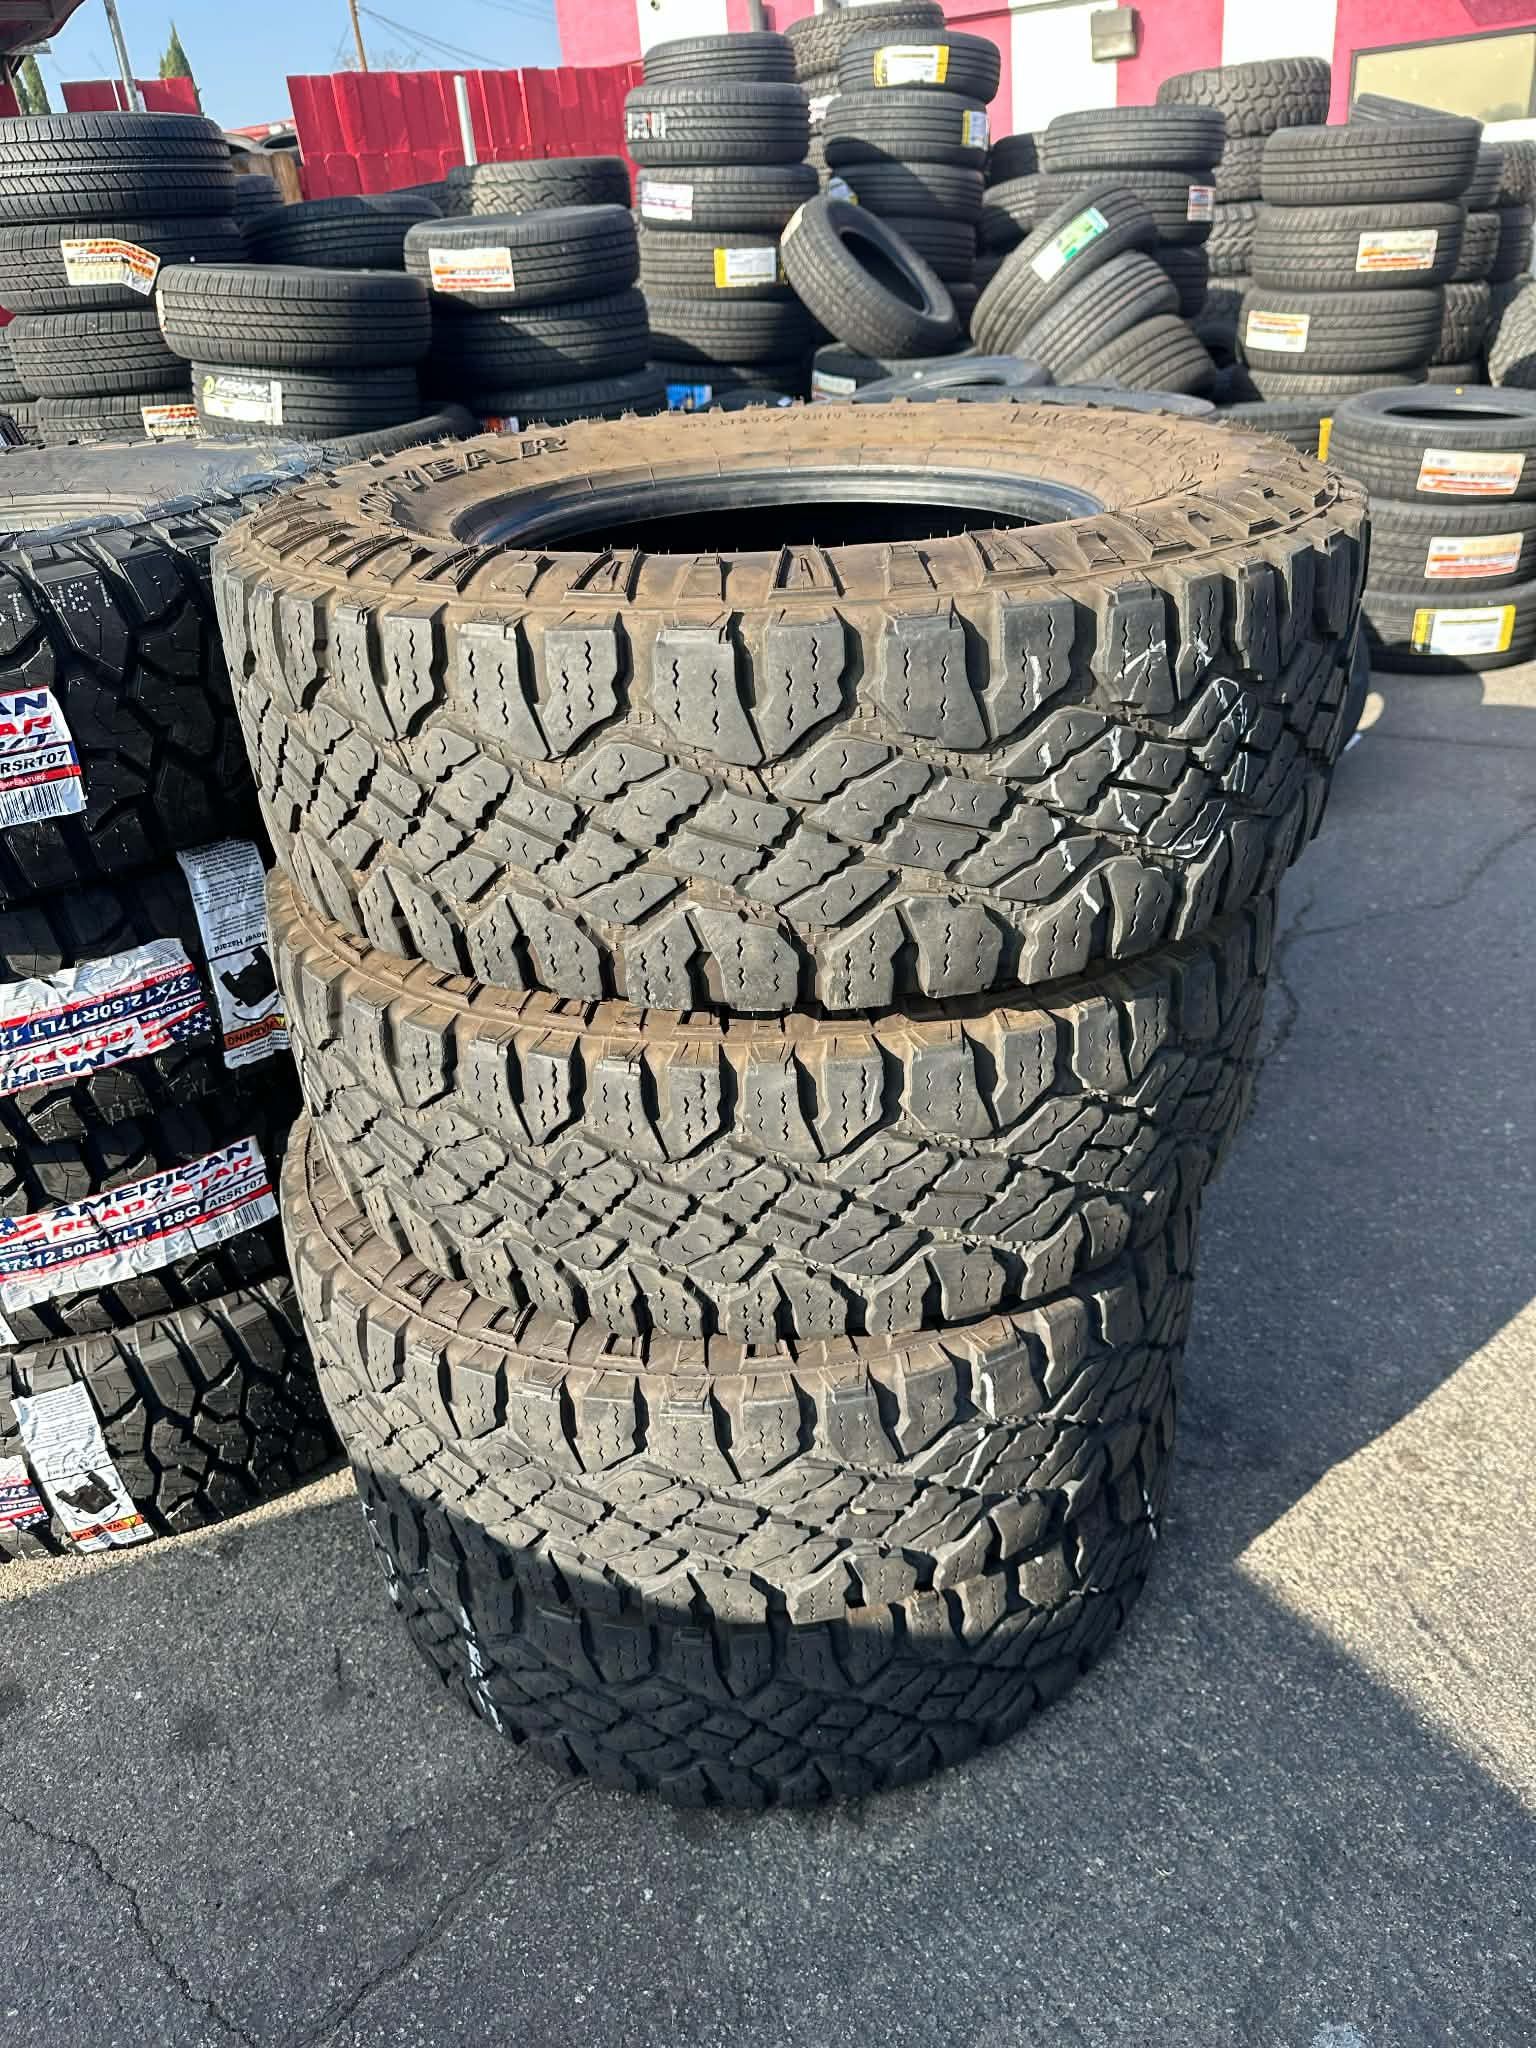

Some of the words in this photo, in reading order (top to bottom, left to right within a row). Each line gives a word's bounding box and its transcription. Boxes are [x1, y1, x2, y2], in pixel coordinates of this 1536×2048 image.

[214, 938, 243, 954] Hazard
[31, 975, 192, 1039] 37x12.50R17LT
[141, 1009, 160, 1022] USA
[32, 1027, 136, 1065] ROAD
[50, 1140, 250, 1221] AMERICAN
[52, 1199, 145, 1237] ROAD
[171, 1156, 253, 1197] STAR
[0, 1223, 147, 1272] 37x12.50R17LT
[151, 1204, 201, 1231] 128Q
[209, 1176, 264, 1209] ARSRT07
